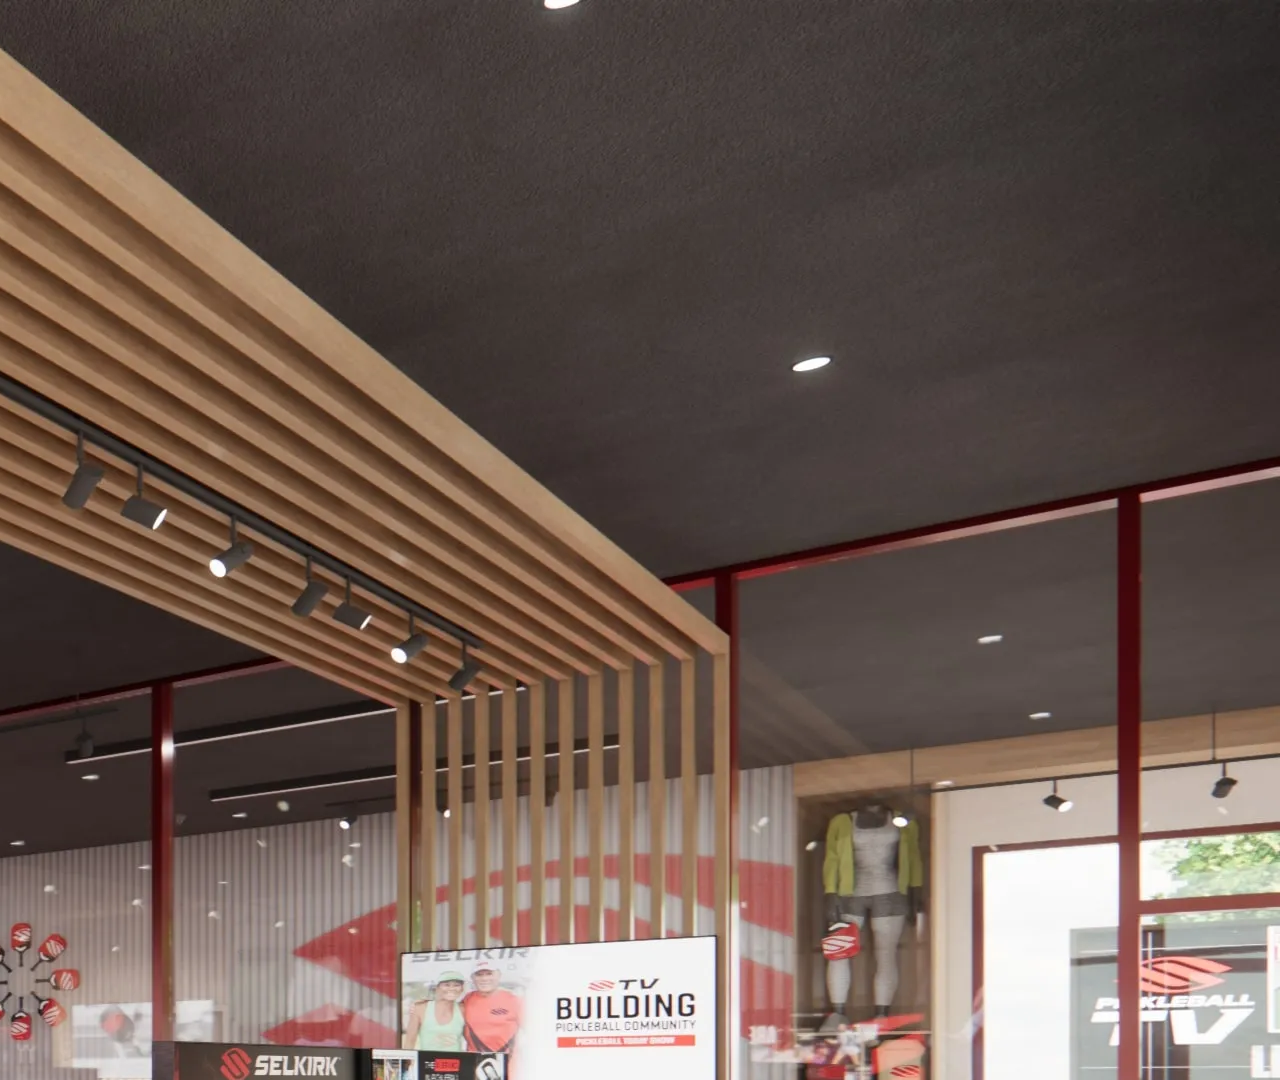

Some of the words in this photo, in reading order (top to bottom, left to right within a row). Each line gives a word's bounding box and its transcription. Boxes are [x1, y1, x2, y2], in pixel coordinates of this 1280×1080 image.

[619, 978, 660, 990] TV
[556, 993, 696, 1020] BUILDING
[556, 1021, 620, 1032] PICKLEBALL
[624, 1020, 697, 1031] COMMUNITY
[254, 1055, 339, 1076] SELKIRK
